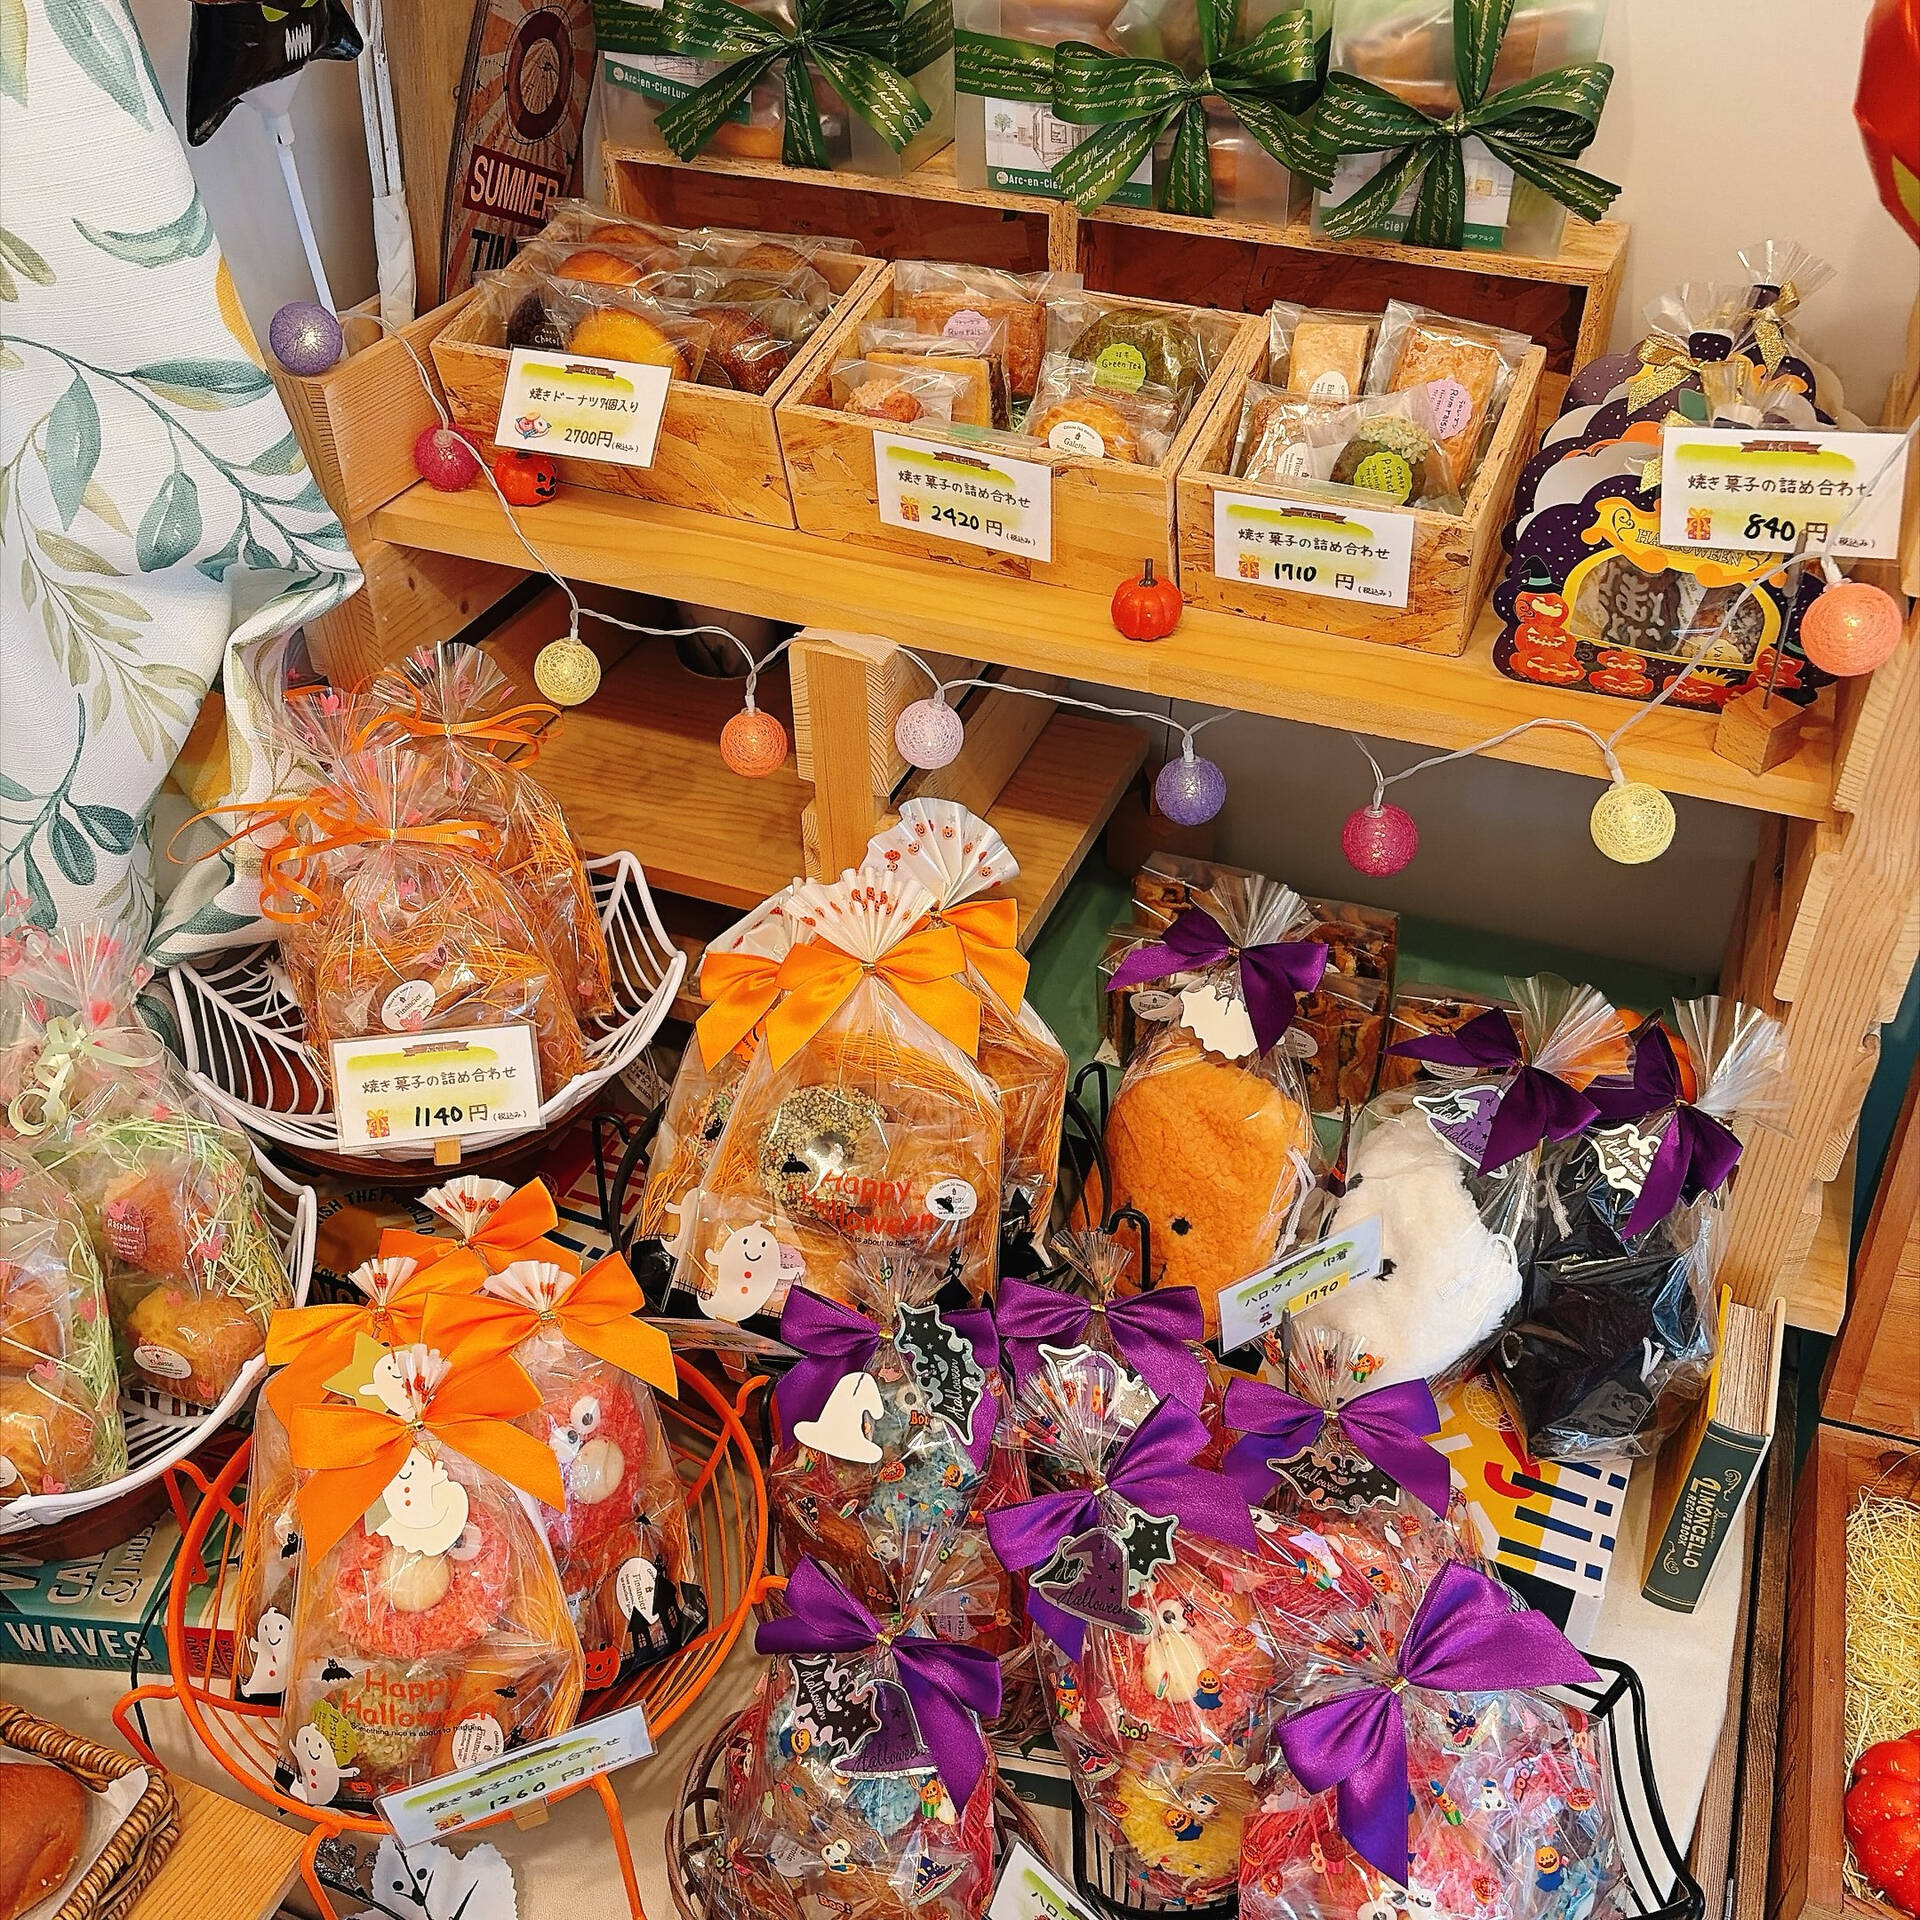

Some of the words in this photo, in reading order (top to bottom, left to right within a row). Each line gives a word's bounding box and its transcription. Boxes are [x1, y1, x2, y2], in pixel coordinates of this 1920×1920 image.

[471, 155, 559, 220] SUMMER
[1101, 359, 1126, 369] Green
[1128, 361, 1141, 370] Tea
[529, 387, 640, 413] 焼きドーナツ7個入り
[564, 428, 613, 448] 2700円
[897, 469, 1032, 509] 焼き菓子の詰め合わせ
[1687, 473, 1873, 498] 焼き菓子の詰め合わせ
[931, 505, 980, 531] 2420
[1743, 512, 1796, 542] 840
[1237, 528, 1390, 561] 焼き菓子の詰め合わせ
[1273, 562, 1318, 583] 1710
[394, 993, 422, 1018] Financier
[362, 1066, 517, 1094] 焼き菓子の詰め合わせ
[415, 1105, 463, 1127] 1140
[1436, 1124, 1486, 1156] Hallowee
[1600, 1137, 1647, 1181] Halloween
[821, 1169, 913, 1206] Happy
[107, 1218, 140, 1234] Raspberry
[1244, 1270, 1309, 1307] ハロウィン
[1304, 1281, 1339, 1305] 1790
[945, 1358, 966, 1421] Halloween
[1289, 1462, 1346, 1495] Halloween
[1682, 1492, 1697, 1524] RECIPE
[1682, 1477, 1722, 1569] LIMONCELLO
[1677, 1523, 1691, 1547] BOOK
[633, 1573, 648, 1611] Financier
[1056, 1585, 1130, 1617] Halloween
[4, 1621, 152, 1661] WAVES
[364, 1668, 461, 1706] Happy
[800, 1670, 827, 1721] Halloween
[341, 1692, 498, 1728] Halloween
[426, 1737, 621, 1814] 焼き菓子の詰め合わせ
[853, 1747, 931, 1773] Halloween
[489, 1781, 546, 1810] 1260
